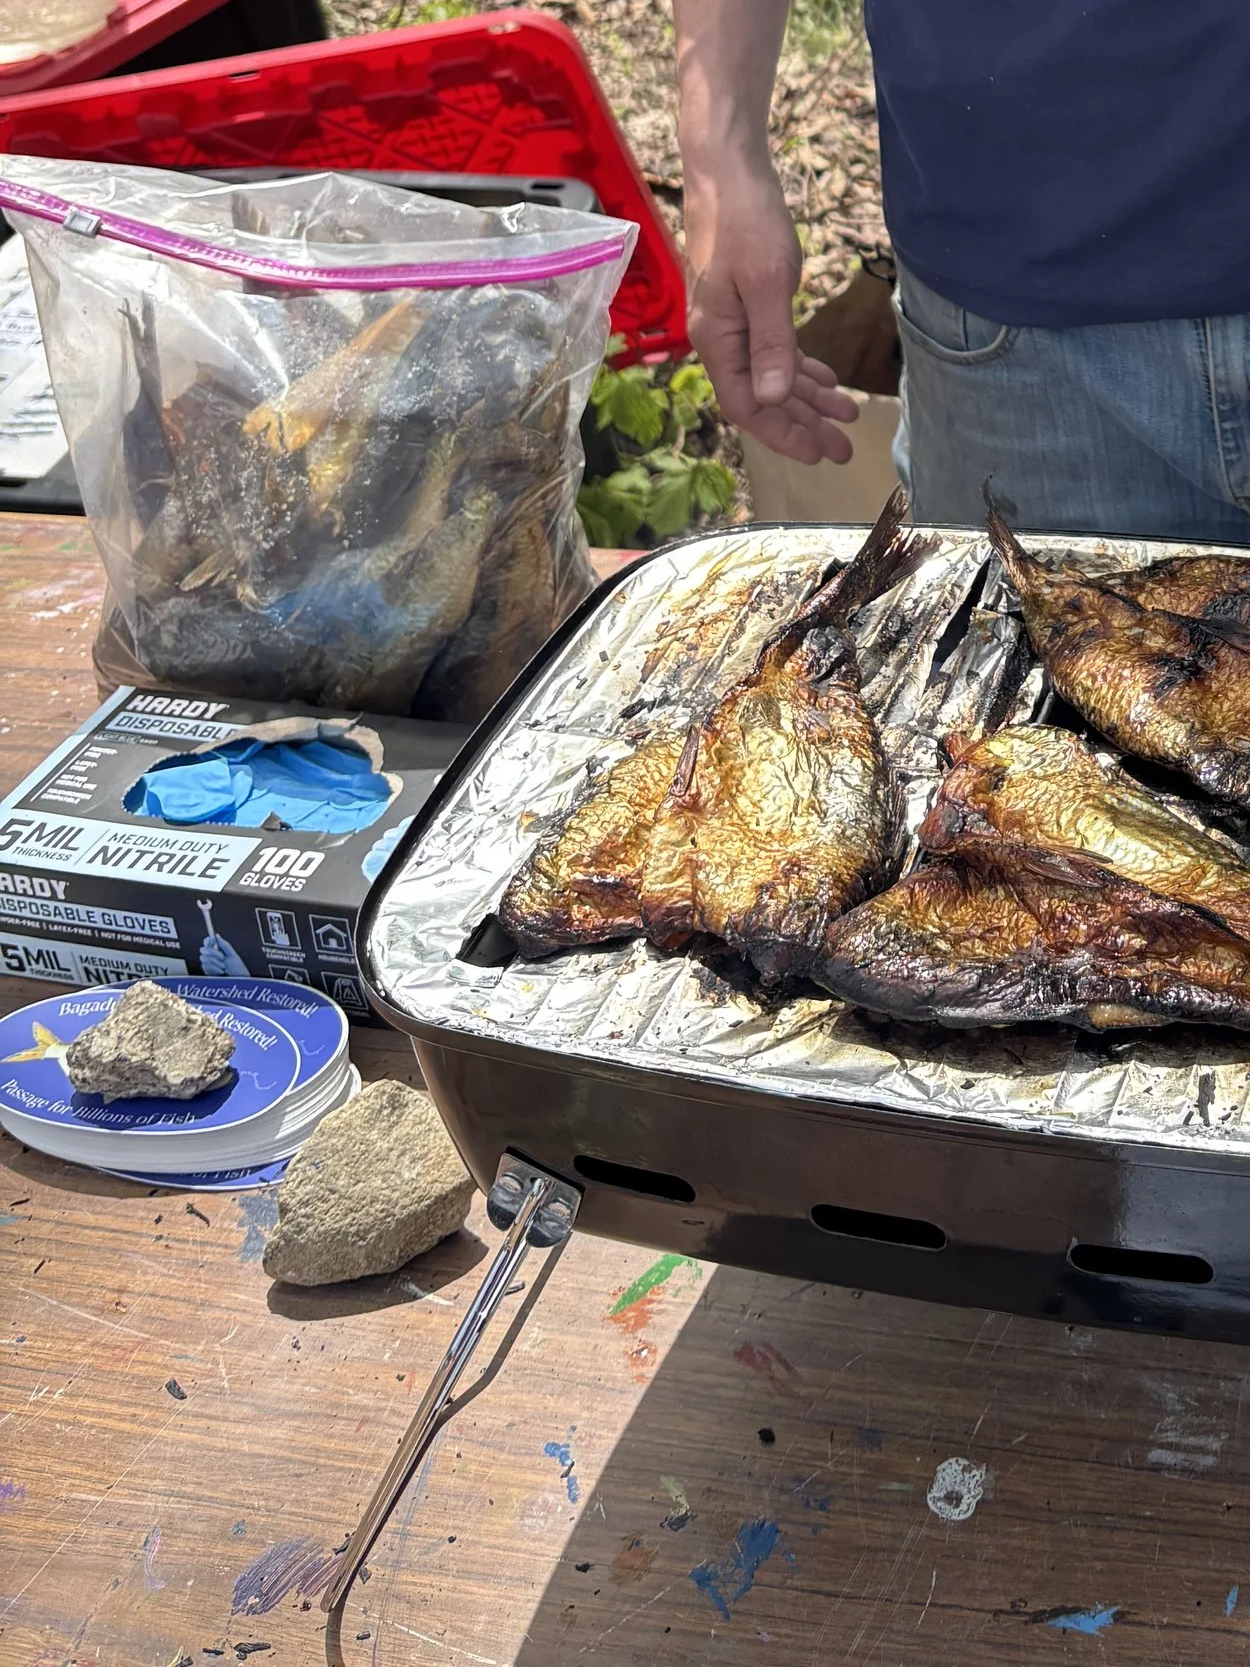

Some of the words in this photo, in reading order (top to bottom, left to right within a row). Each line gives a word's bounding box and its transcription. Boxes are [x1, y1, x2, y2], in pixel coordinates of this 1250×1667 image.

[126, 695, 223, 719] HARDY
[21, 822, 84, 852] MIL
[107, 832, 178, 850] MEDIUM
[178, 840, 230, 855] DUTY
[12, 847, 72, 862] THICKNESS
[87, 845, 231, 880] NITRILE
[252, 847, 326, 878] 100
[240, 872, 306, 892] GLOVES
[102, 912, 171, 934] GLOVES
[23, 946, 71, 972] MIL
[79, 955, 131, 971] MEDIUM
[134, 962, 168, 976] DUTY
[177, 984, 257, 1000] Watershed
[256, 988, 319, 1019] Restored!
[219, 1013, 278, 1052] Restored!
[0, 1078, 49, 1109] Passage
[48, 1100, 74, 1117] for
[72, 1106, 134, 1124] Billions
[136, 1112, 158, 1124] of
[158, 1112, 196, 1125] Fish
